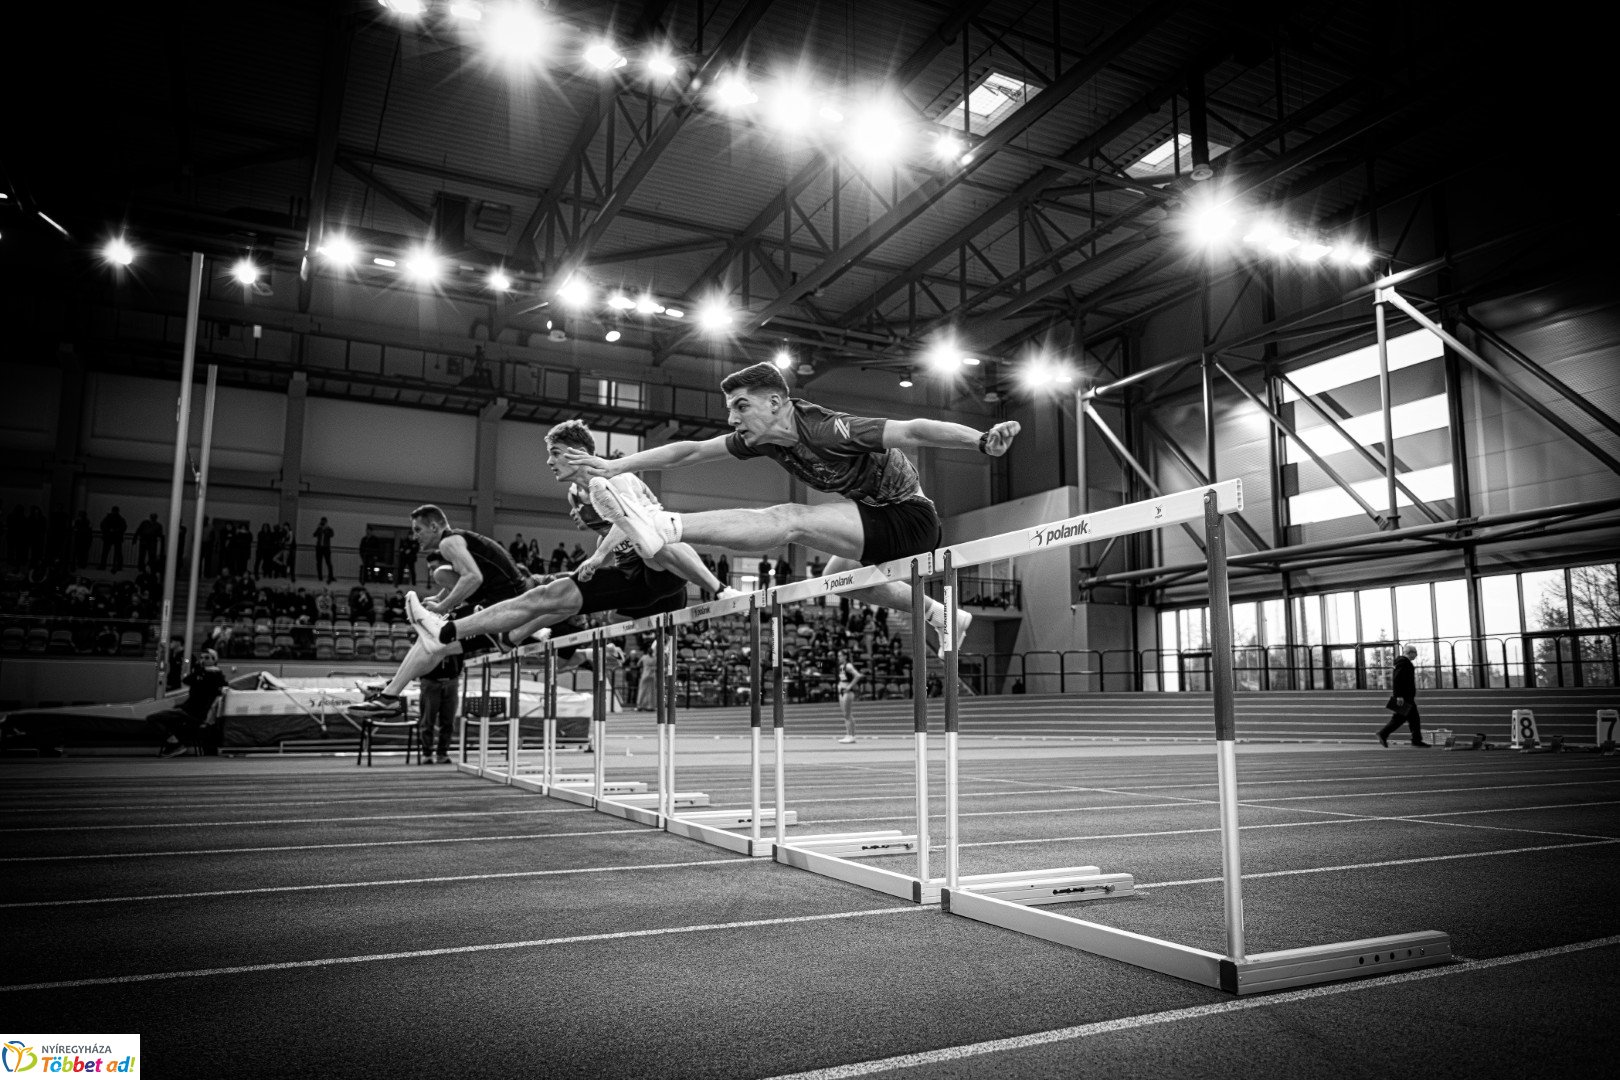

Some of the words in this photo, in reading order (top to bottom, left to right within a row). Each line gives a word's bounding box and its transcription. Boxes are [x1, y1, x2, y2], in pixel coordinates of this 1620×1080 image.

[1046, 520, 1088, 545] polanik
[830, 574, 853, 590] polanik
[1520, 716, 1534, 738] 8
[1601, 717, 1617, 741] 7
